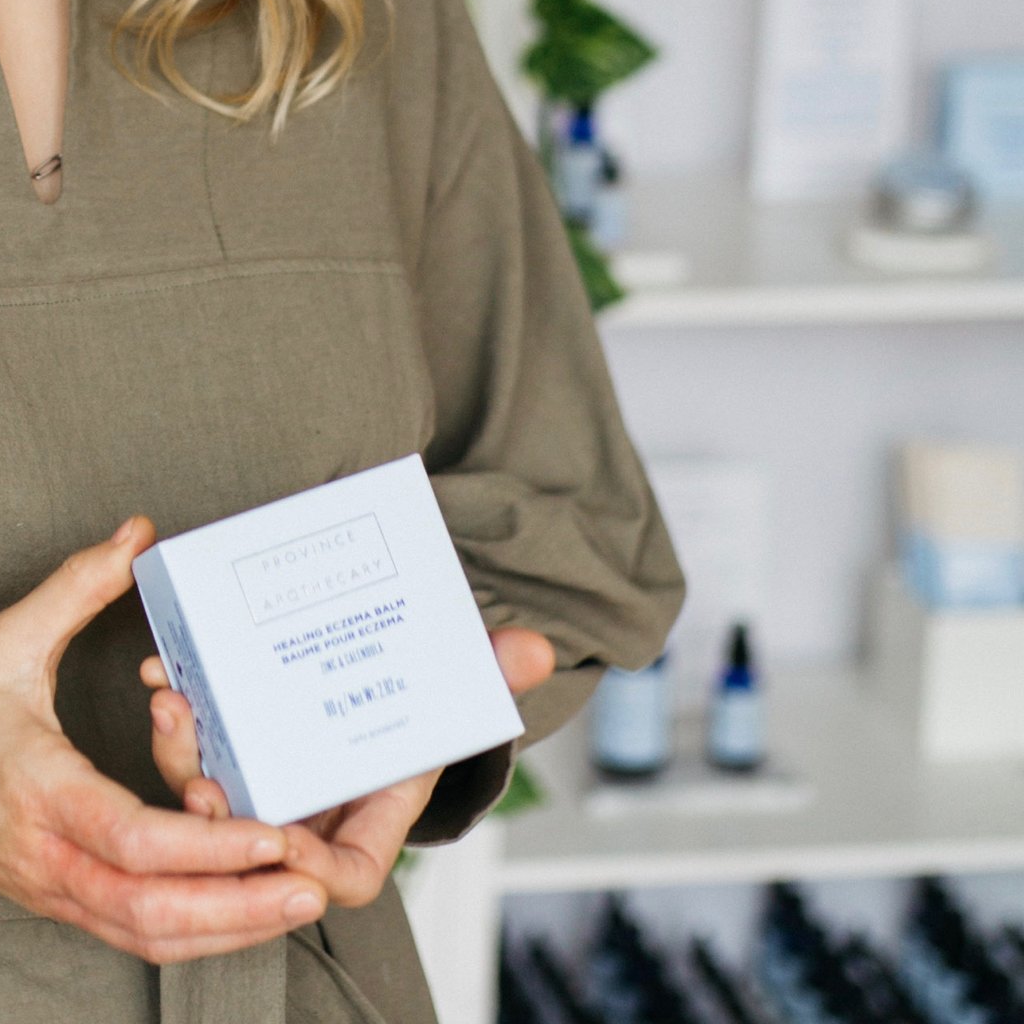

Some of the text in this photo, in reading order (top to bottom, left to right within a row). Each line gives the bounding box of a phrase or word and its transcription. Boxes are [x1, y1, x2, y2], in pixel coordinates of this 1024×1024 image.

[262, 529, 355, 572] PROVINCE
[263, 559, 381, 611] APOTHECARY
[272, 597, 406, 652] HEALING ECZEMA BALM
[281, 614, 405, 665] BAUME POUR ECZEMA
